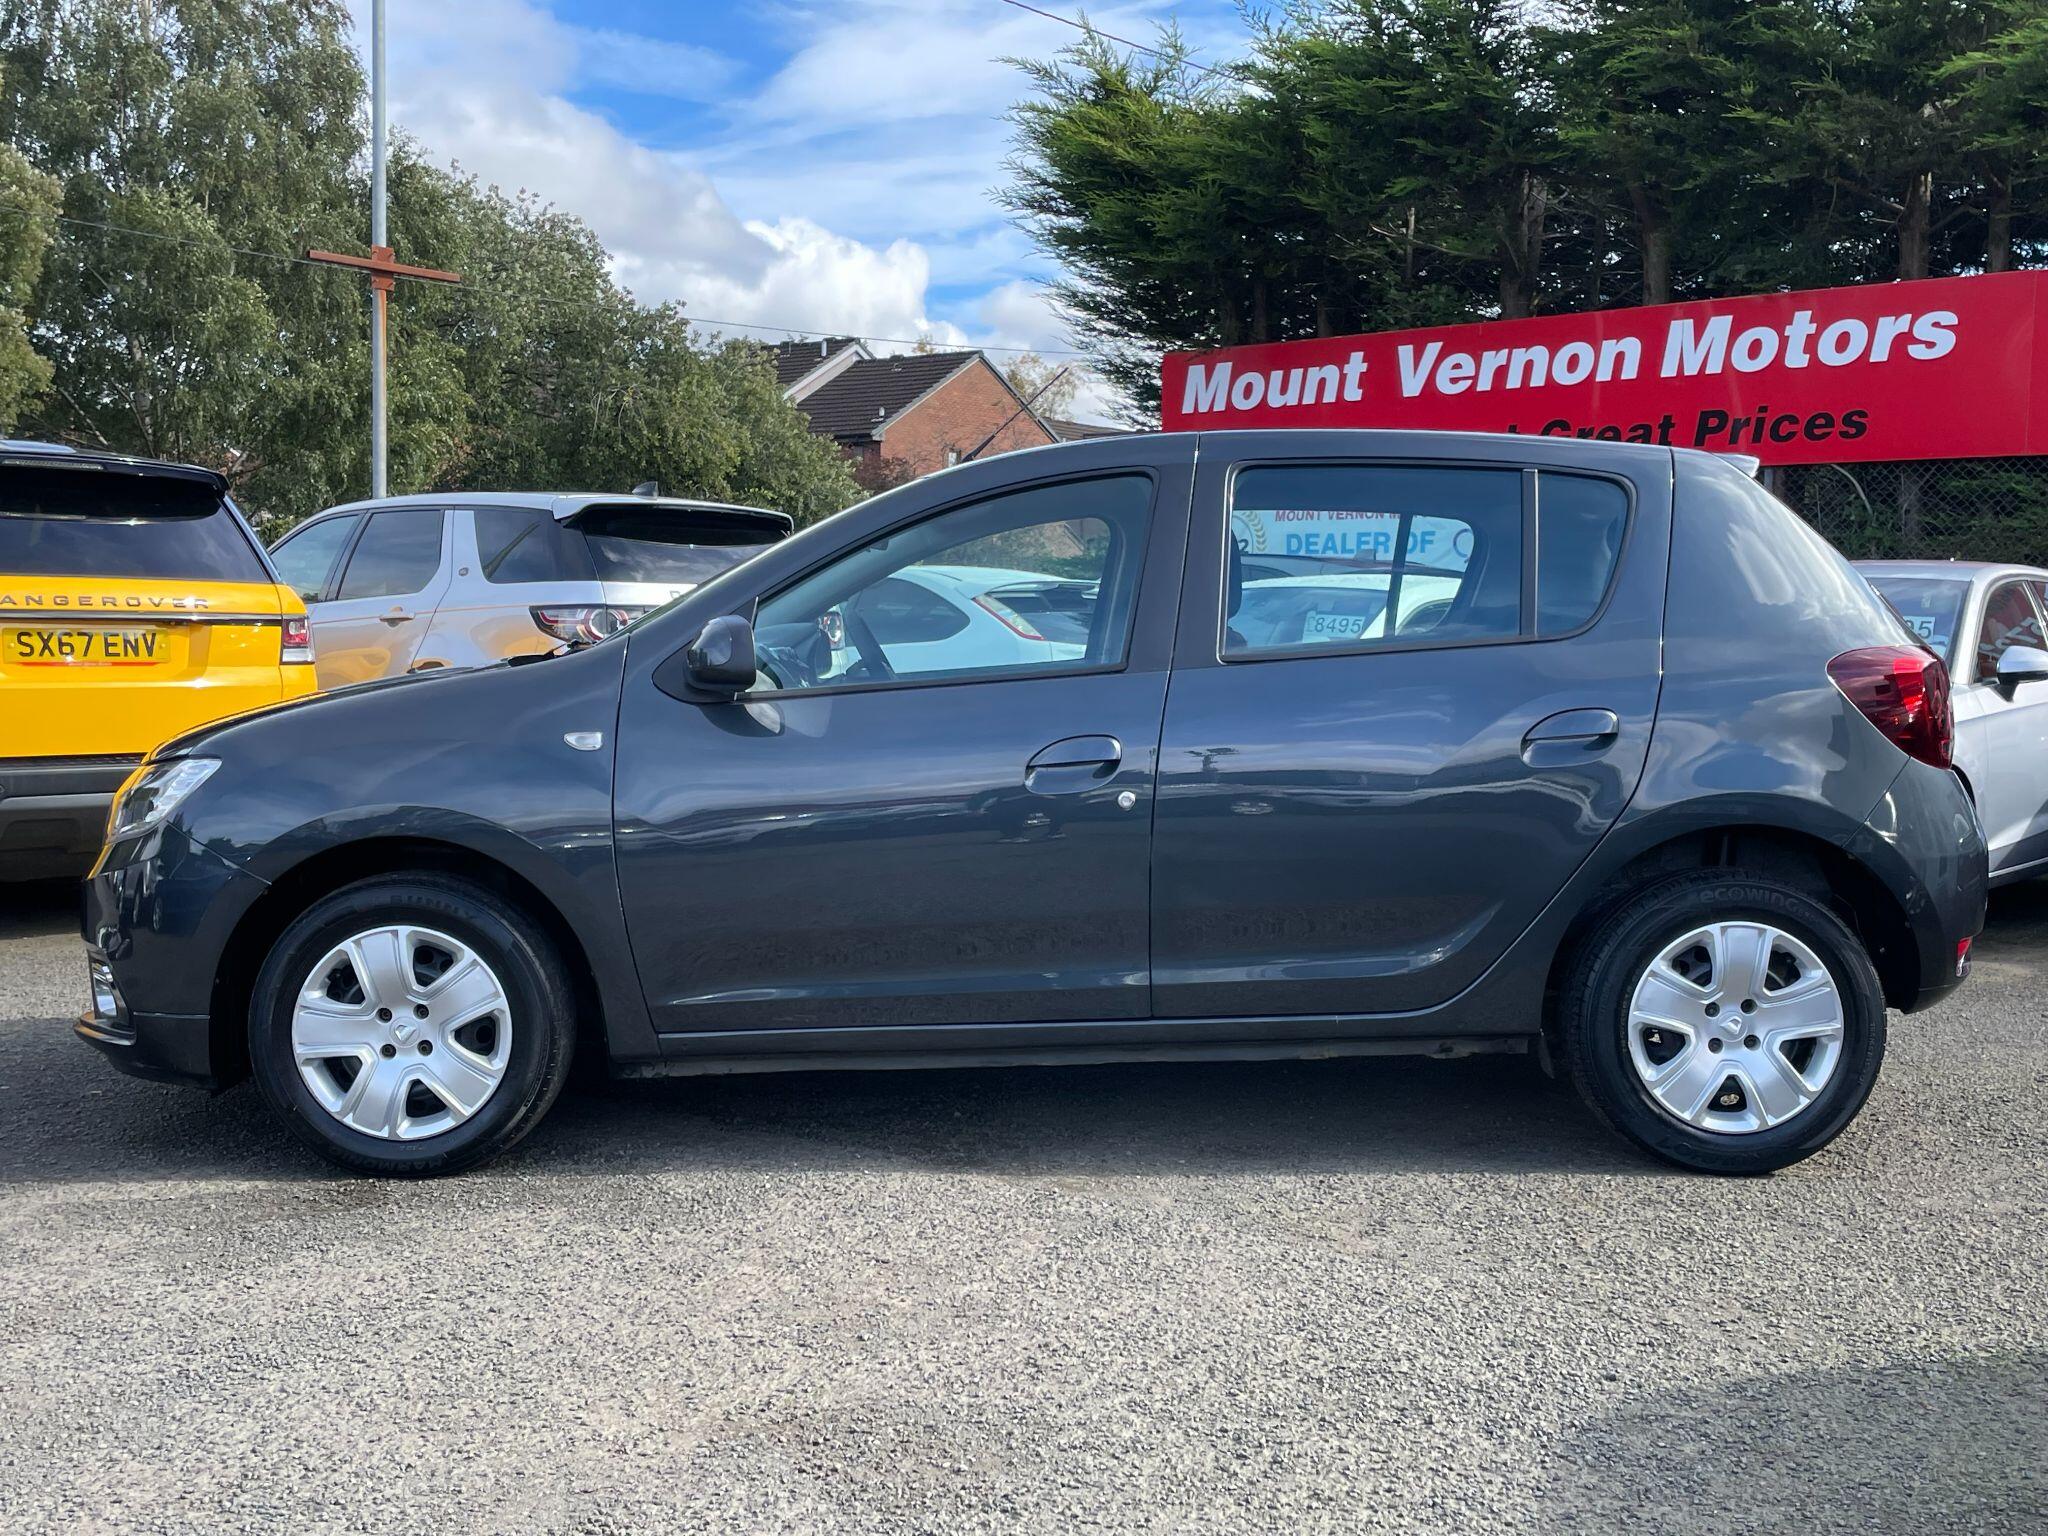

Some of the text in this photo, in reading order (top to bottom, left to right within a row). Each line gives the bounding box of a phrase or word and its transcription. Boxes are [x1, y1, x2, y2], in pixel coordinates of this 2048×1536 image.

[1182, 309, 1959, 413] Mount Vernon Motors
[1694, 405, 1869, 447] Prices
[1275, 510, 1322, 522] MOUNT
[1286, 531, 1391, 554] DEALER
[17, 631, 157, 657] SX67 ENV
